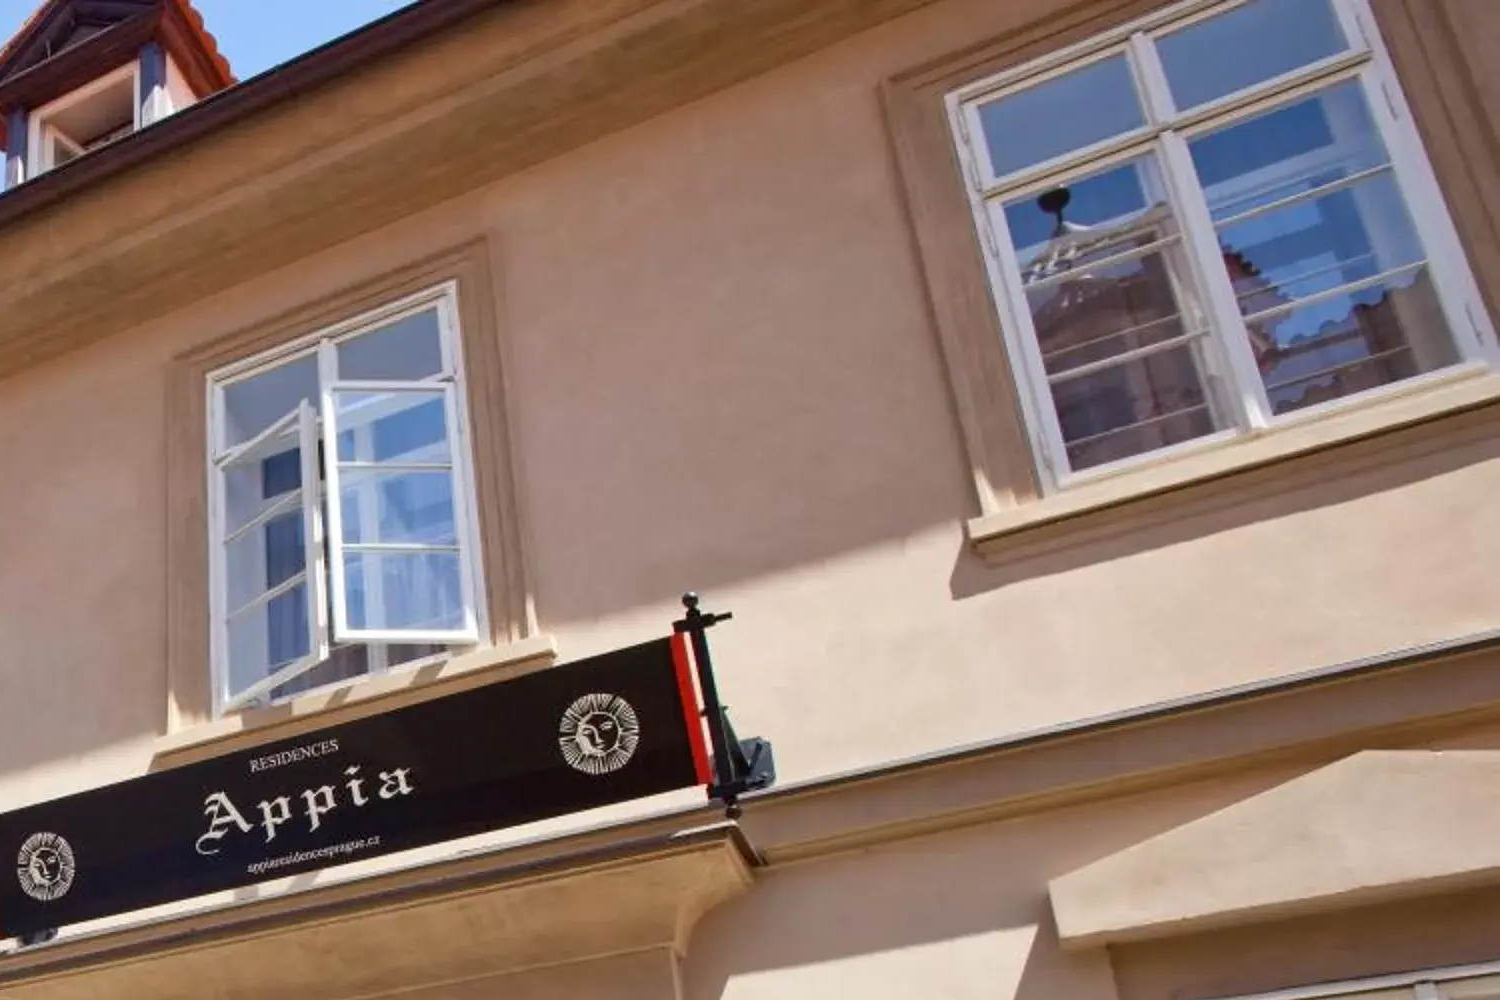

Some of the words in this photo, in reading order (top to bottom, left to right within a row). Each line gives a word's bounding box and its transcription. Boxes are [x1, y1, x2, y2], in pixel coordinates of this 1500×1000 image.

[249, 738, 339, 773] RESIDENCES
[195, 763, 414, 855] Appia
[246, 834, 382, 874] appiaresidencesprague.cz
